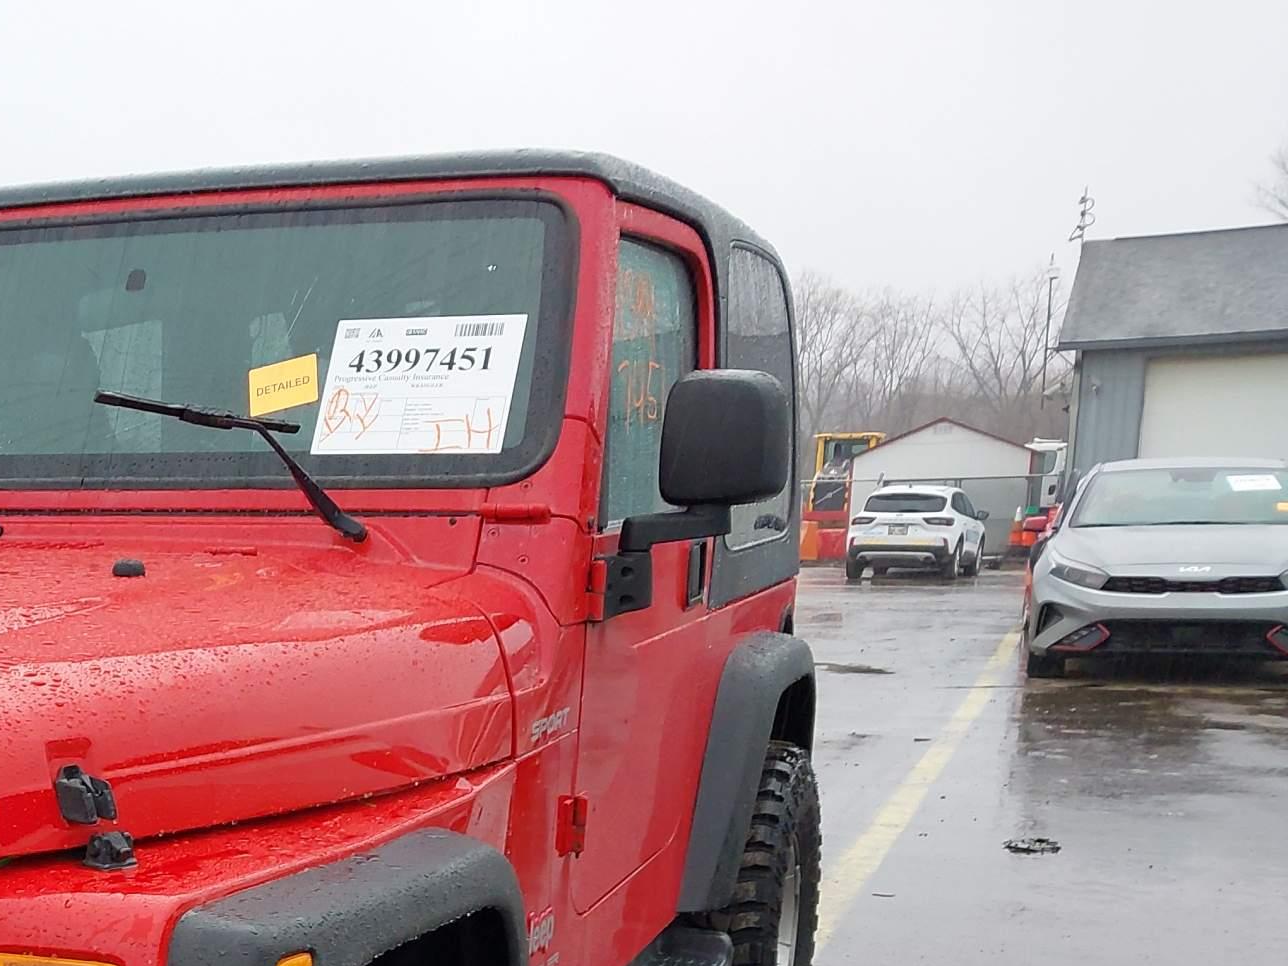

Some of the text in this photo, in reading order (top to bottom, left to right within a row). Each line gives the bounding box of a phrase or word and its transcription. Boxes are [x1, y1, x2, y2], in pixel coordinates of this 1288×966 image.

[348, 345, 494, 373] 43997451
[256, 375, 311, 397] DETAILED
[334, 373, 450, 383] Progressive Casualty Insurance
[530, 707, 571, 743] SPORT
